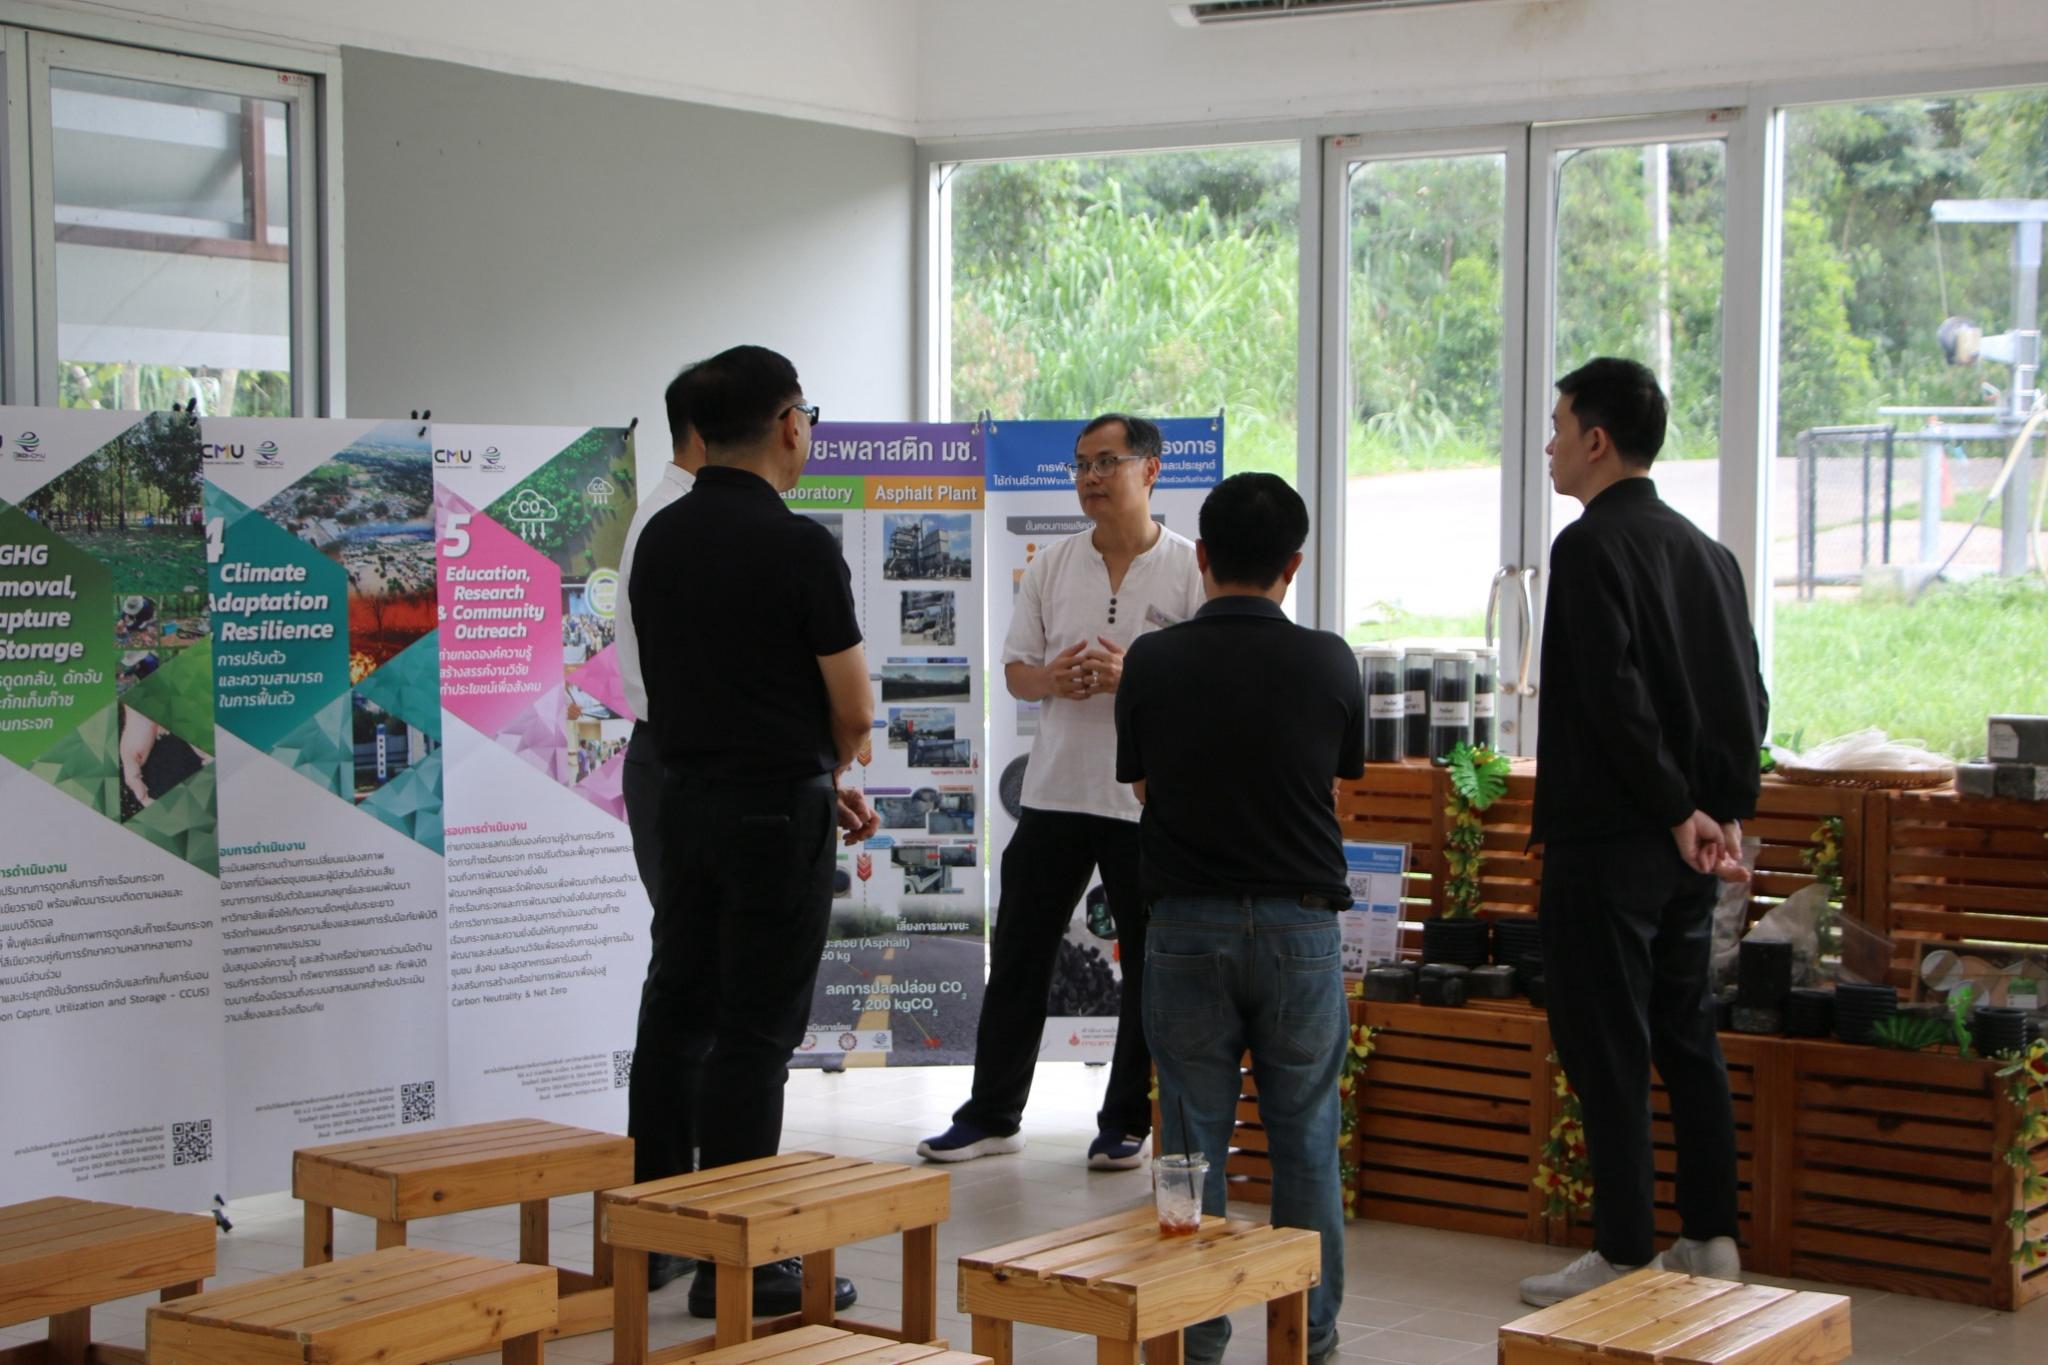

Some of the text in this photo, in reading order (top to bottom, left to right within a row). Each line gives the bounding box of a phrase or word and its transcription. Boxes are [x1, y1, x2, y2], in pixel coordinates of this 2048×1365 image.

[200, 443, 245, 459] CMU
[434, 449, 472, 463] CMU
[807, 436, 978, 461] ยะพลาสติก มช.
[874, 484, 977, 503] Asphalt Plant
[442, 513, 473, 558] 5
[0, 545, 49, 565] GHG
[221, 562, 307, 583] Climate
[446, 566, 531, 582] Education,
[454, 584, 526, 602] Research
[438, 603, 546, 622] & Community
[222, 621, 335, 641] Resilience
[454, 622, 528, 641] Outreach
[218, 650, 287, 667] การปรับตัว
[63, 668, 104, 685] ดักจับ
[219, 671, 324, 687] และความสามารถ
[219, 687, 296, 708] ในการฟื้นตัว
[0, 717, 54, 732] นกระจก
[860, 936, 911, 954] (Asphalt)
[837, 950, 851, 963] kg
[825, 979, 936, 996] ลดการปลดปล่อย
[56, 1001, 105, 1013] Utilization
[108, 996, 127, 1007] and
[130, 993, 167, 1004] Storage
[452, 996, 481, 1007] Carbon
[483, 991, 522, 1004] Neutrality
[852, 998, 891, 1013] 2,200
